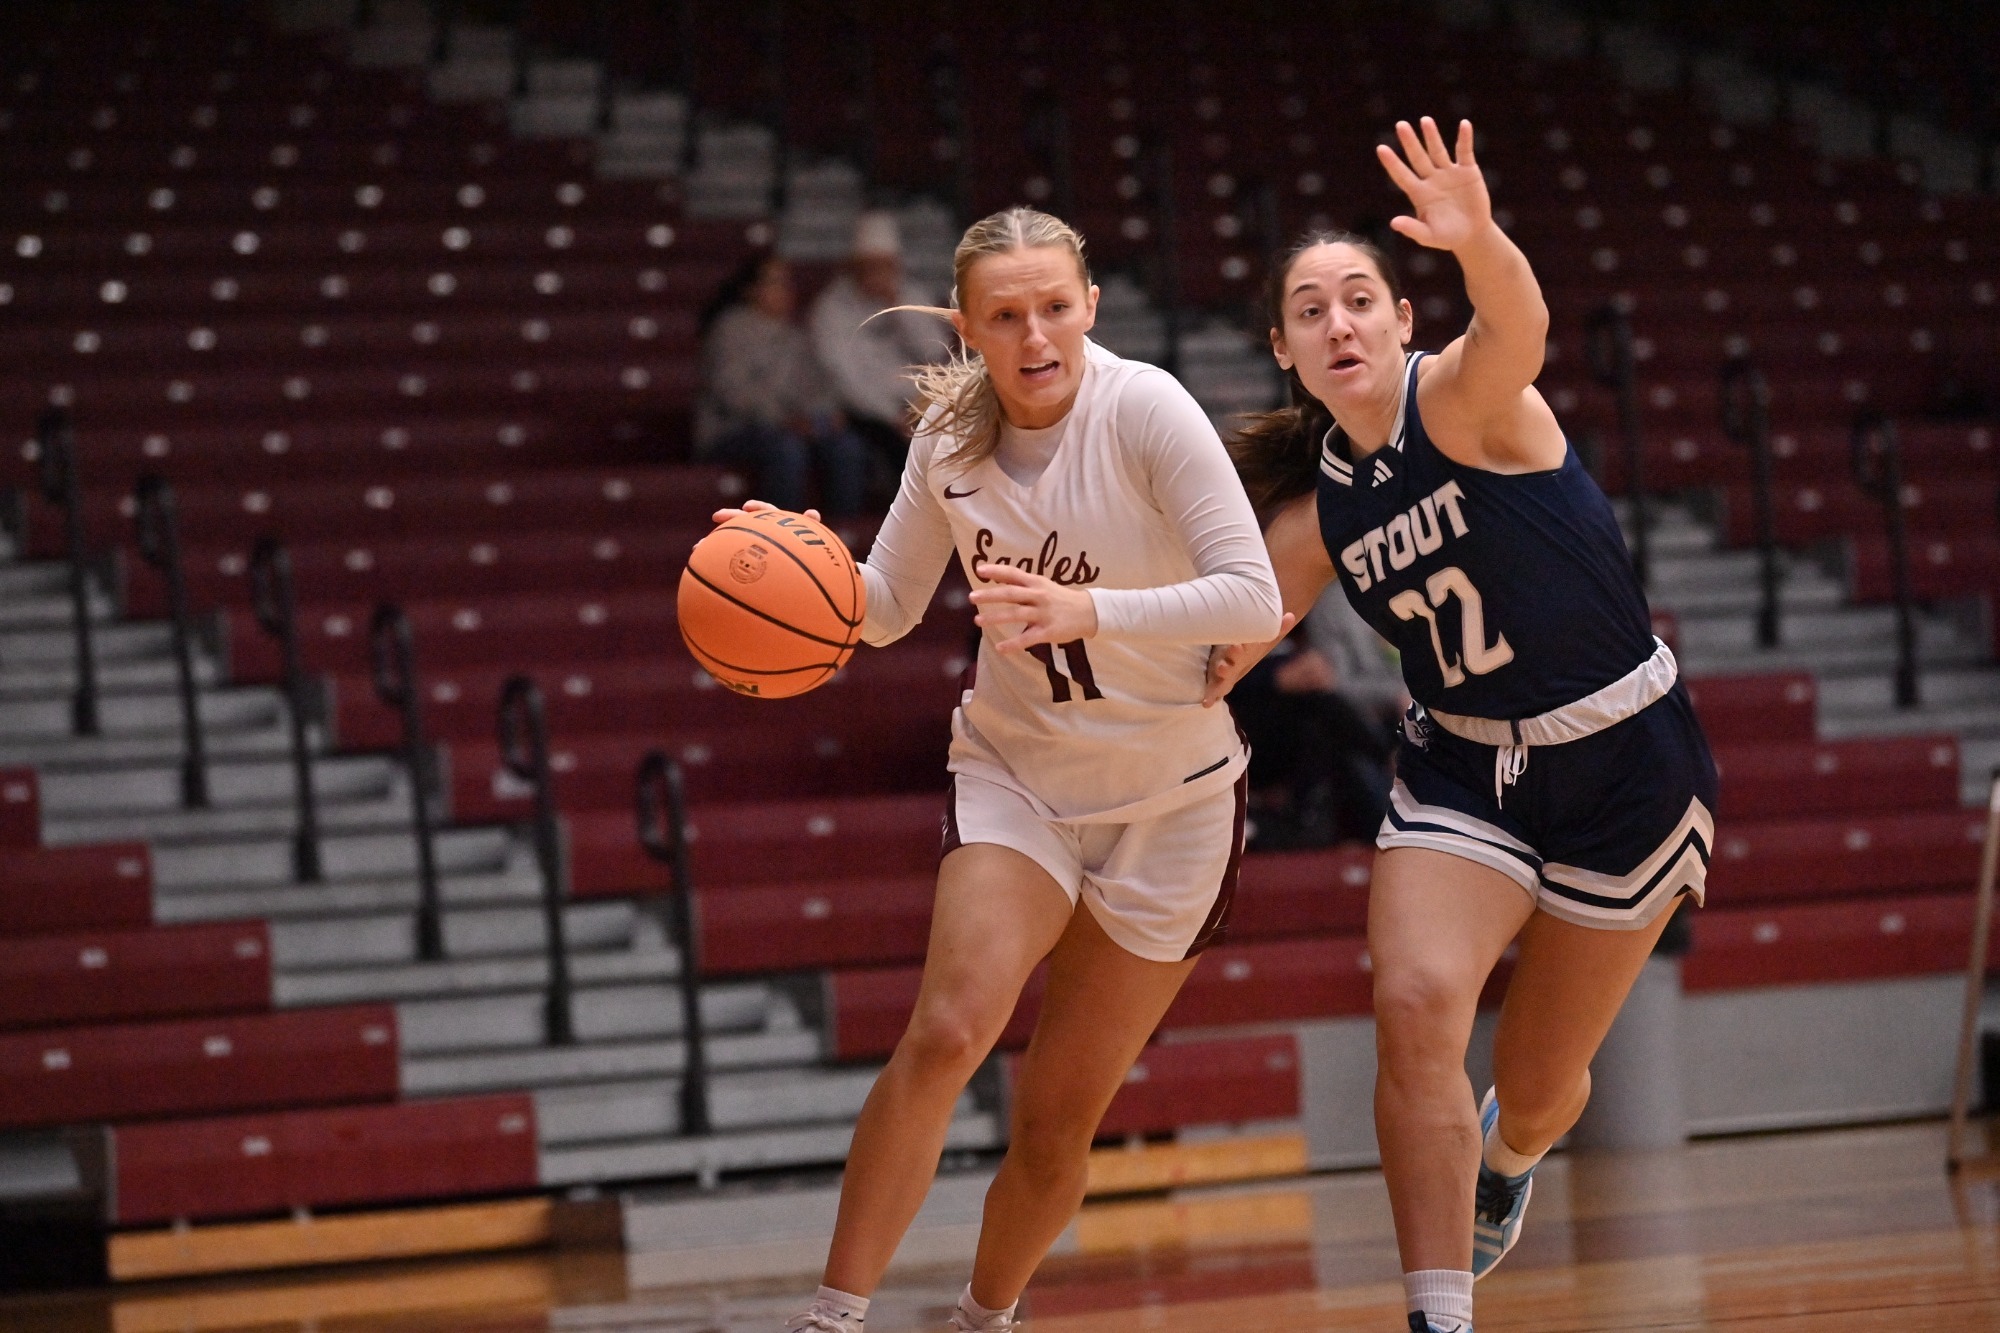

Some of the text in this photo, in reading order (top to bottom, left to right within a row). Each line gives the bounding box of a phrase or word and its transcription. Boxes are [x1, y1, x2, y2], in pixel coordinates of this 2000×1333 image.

[1341, 478, 1470, 594] STOUT
[1024, 637, 1106, 703] 11
[1388, 566, 1515, 689] 22
